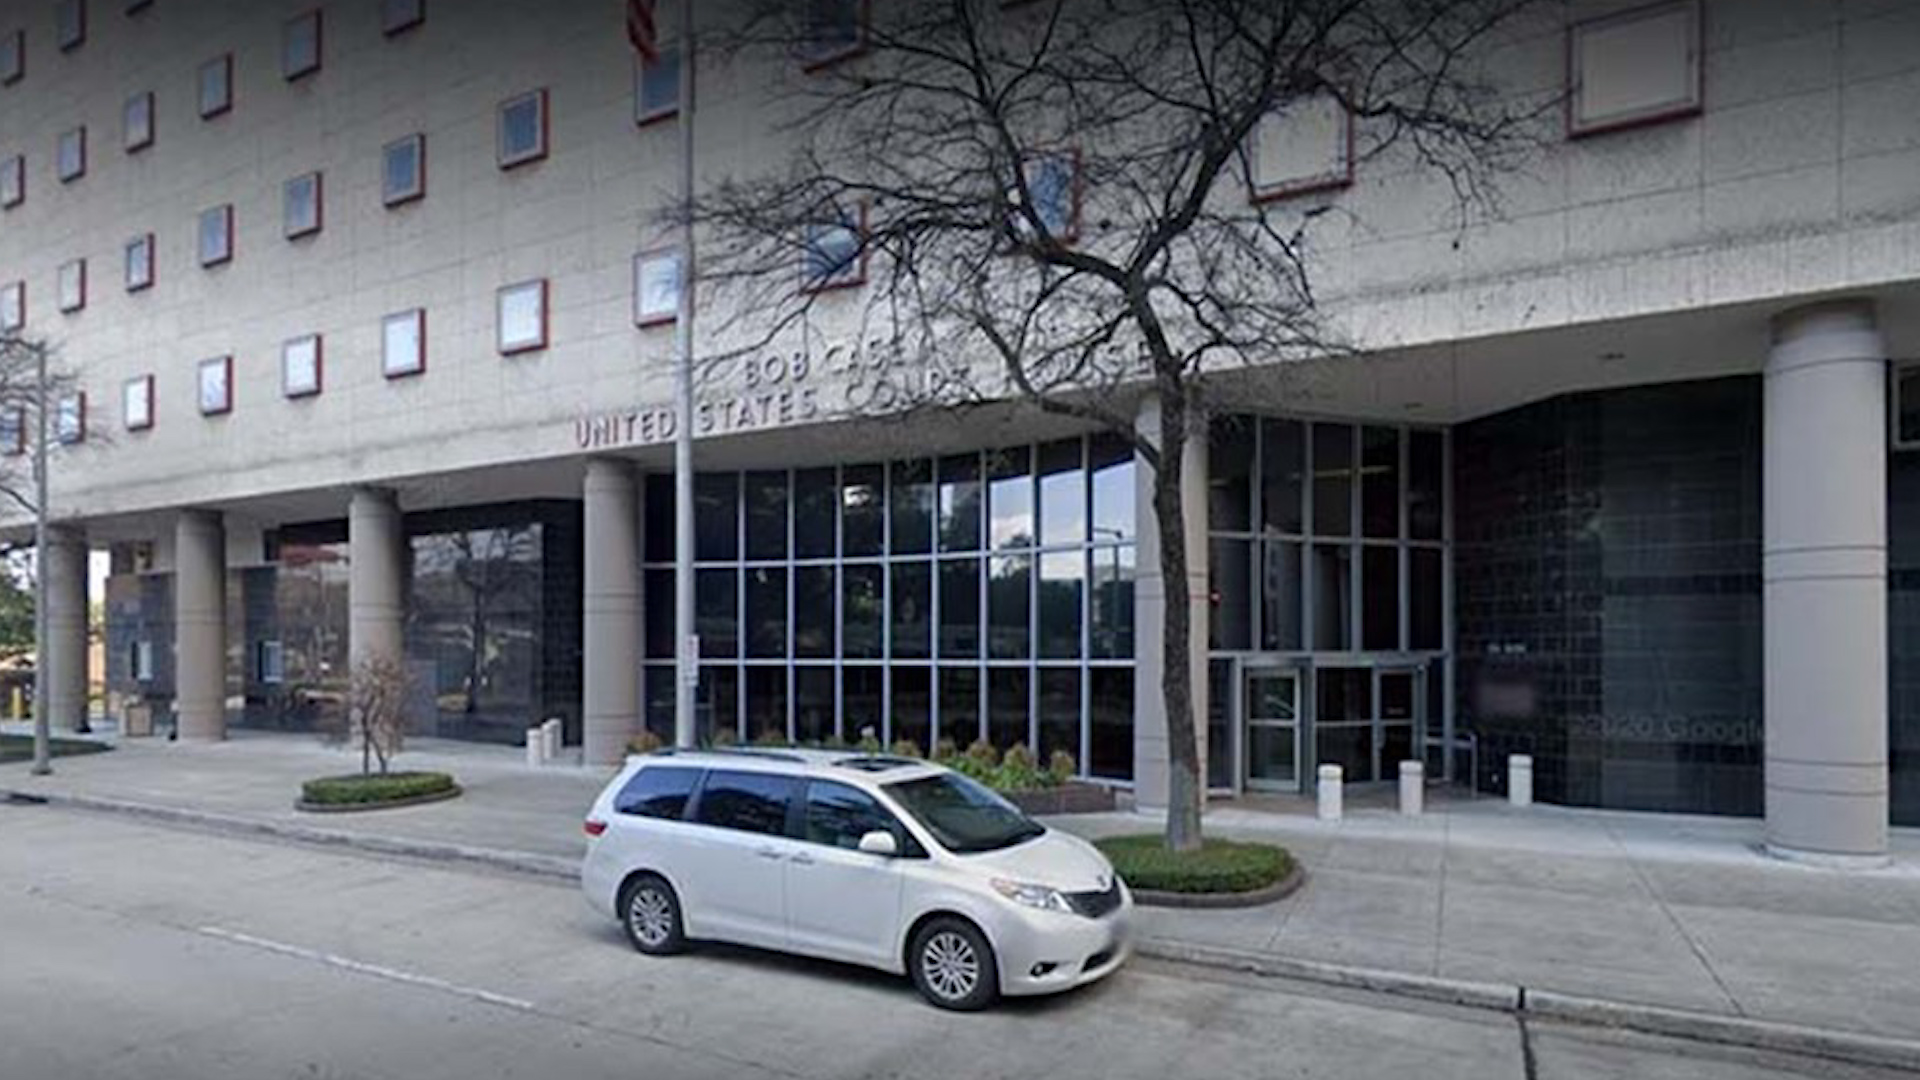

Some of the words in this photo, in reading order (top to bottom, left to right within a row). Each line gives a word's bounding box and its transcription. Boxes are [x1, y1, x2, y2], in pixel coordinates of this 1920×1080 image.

[745, 350, 808, 389] BOB
[575, 412, 676, 447] UNITED
[698, 390, 817, 430] STATES
